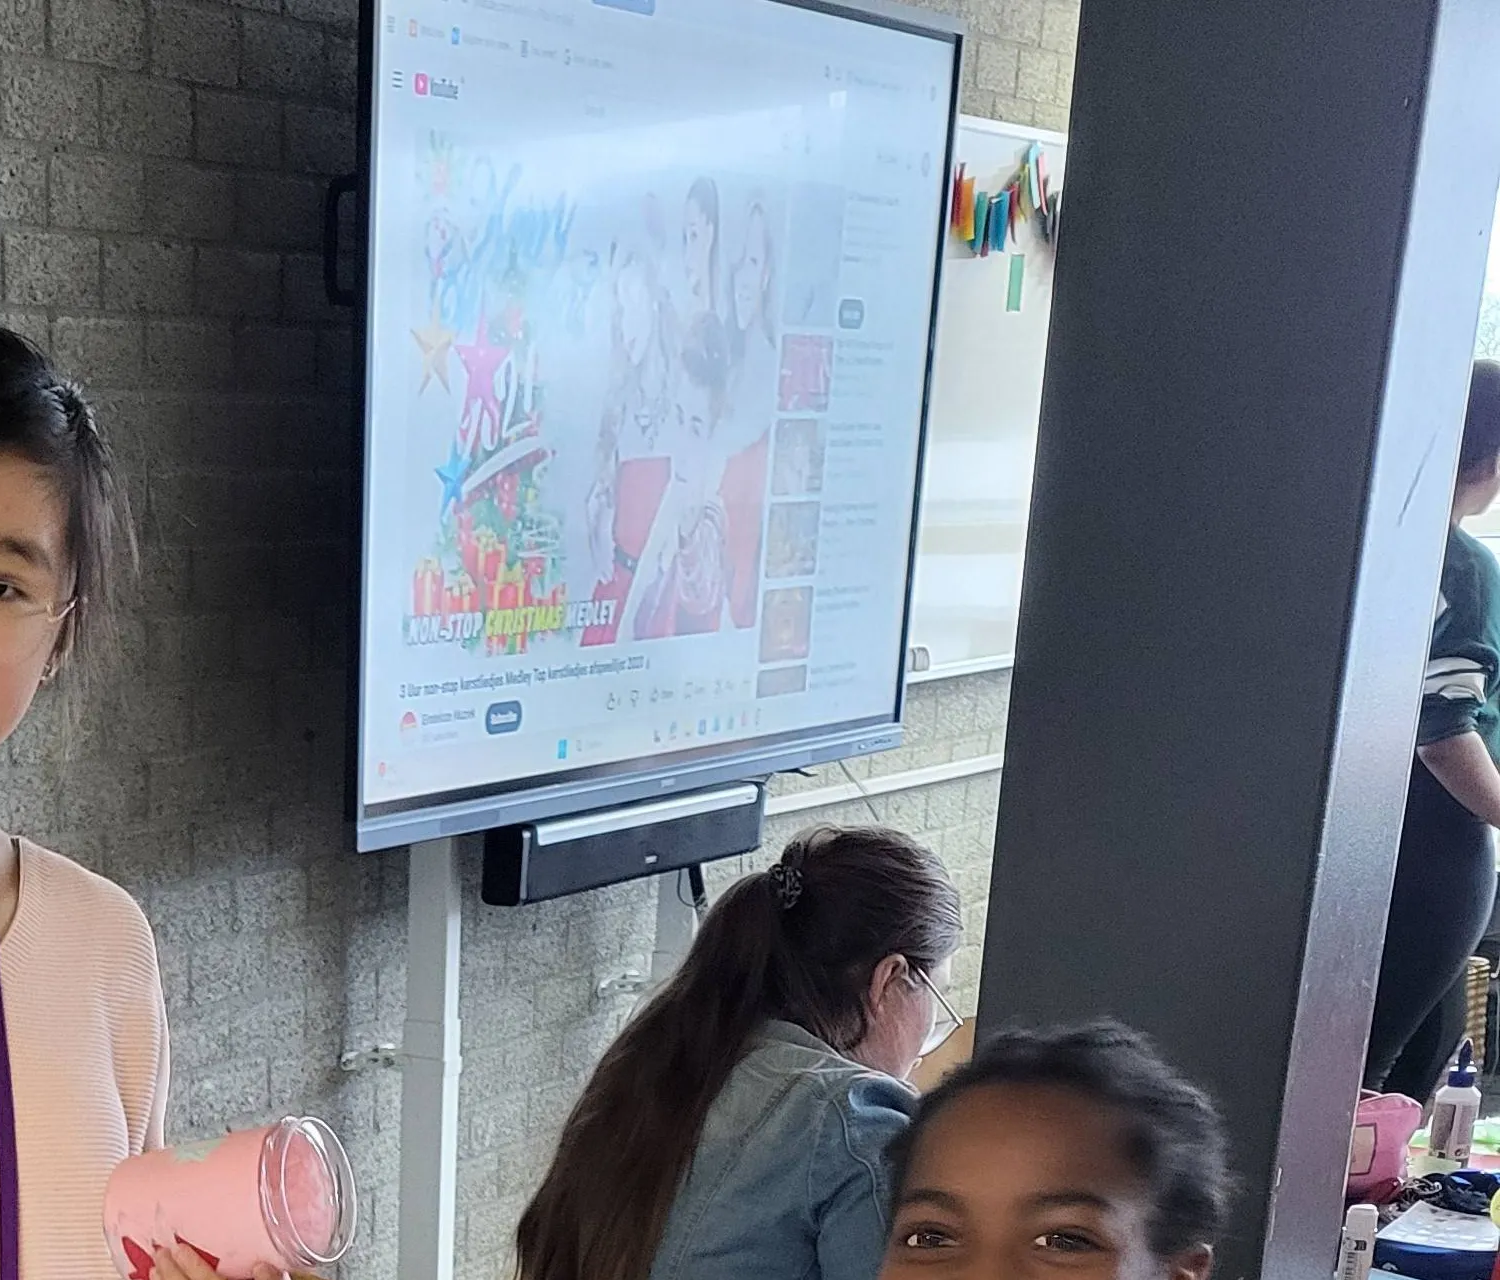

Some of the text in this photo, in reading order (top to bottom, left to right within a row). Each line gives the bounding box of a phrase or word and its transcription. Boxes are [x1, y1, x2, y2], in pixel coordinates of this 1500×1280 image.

[407, 612, 484, 646] NON-STOP
[564, 599, 618, 630] MEDLEY
[506, 669, 531, 687] Medley
[533, 667, 546, 684] Top
